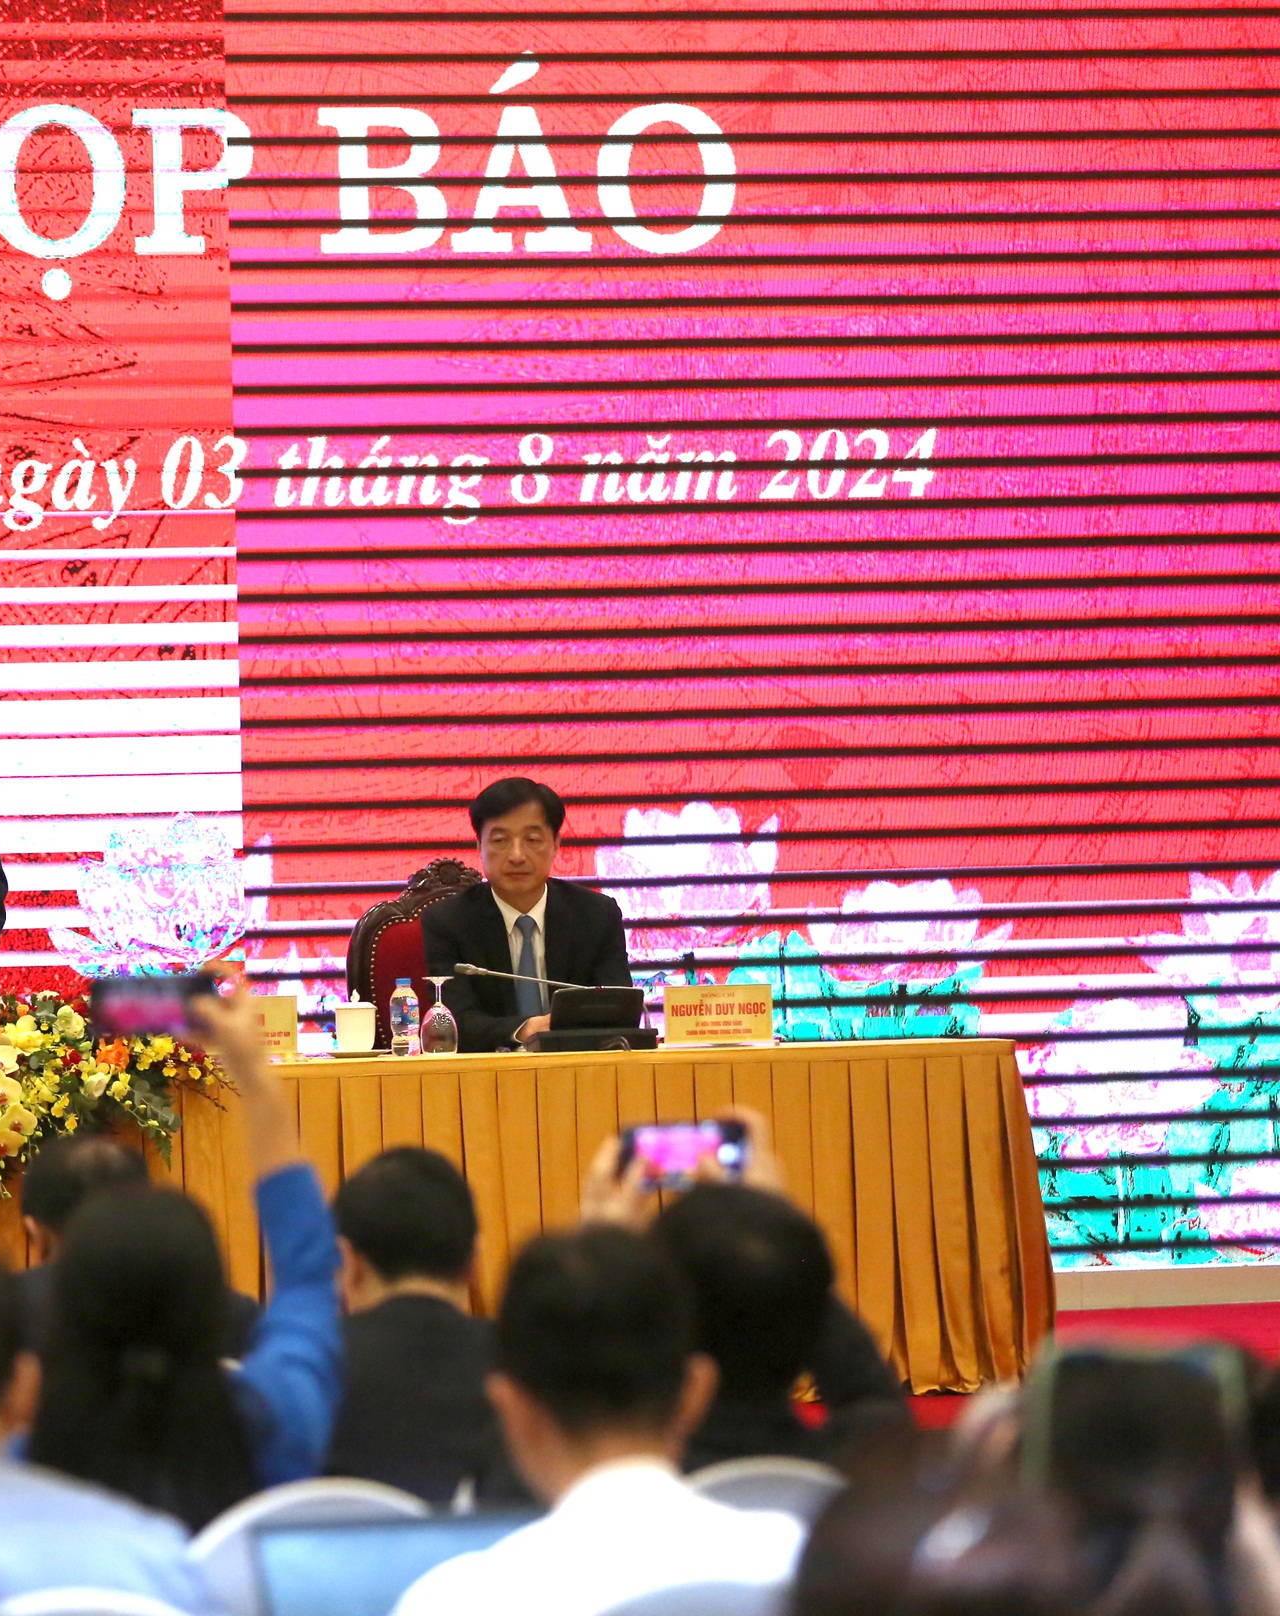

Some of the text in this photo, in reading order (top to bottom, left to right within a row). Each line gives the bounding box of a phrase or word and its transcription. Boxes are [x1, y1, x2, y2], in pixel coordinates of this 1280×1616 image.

[317, 52, 736, 254] BÁO
[161, 435, 248, 511] 03
[274, 435, 490, 525] tháng
[509, 433, 555, 504] 8
[581, 433, 738, 502] năm
[759, 429, 939, 501] 2024
[671, 999, 766, 1018] NGUYỄN DUY NGỌC
